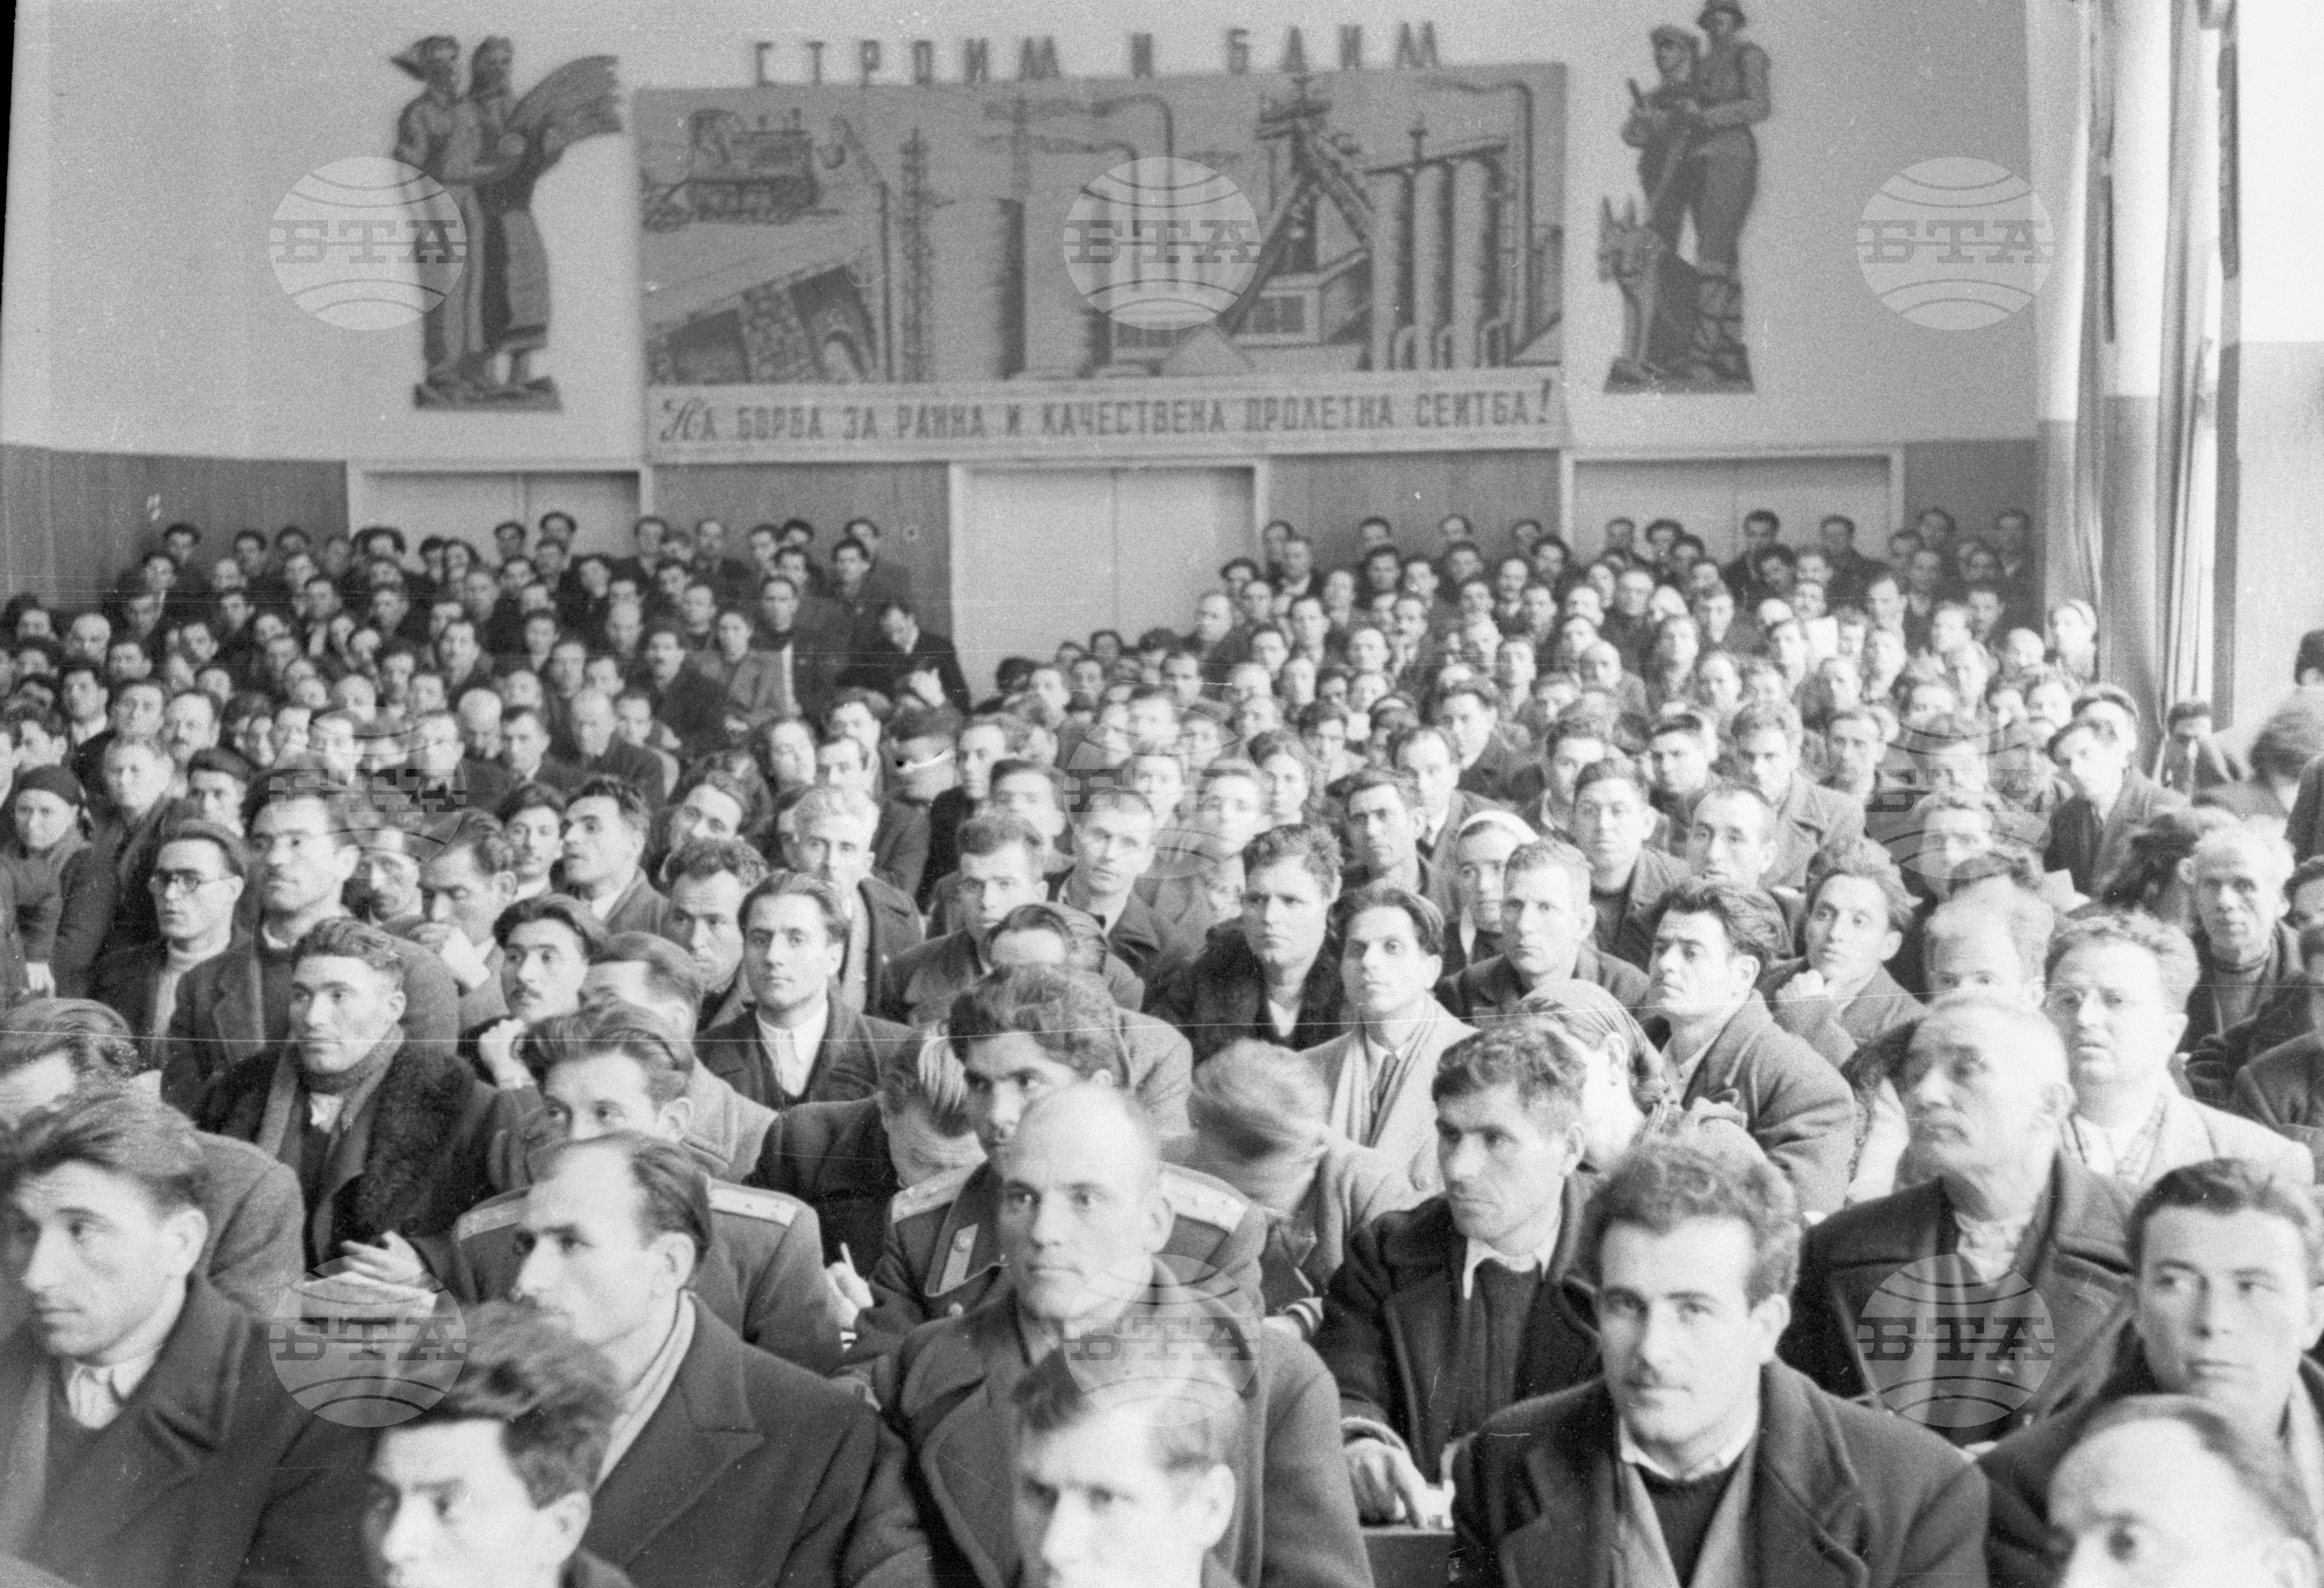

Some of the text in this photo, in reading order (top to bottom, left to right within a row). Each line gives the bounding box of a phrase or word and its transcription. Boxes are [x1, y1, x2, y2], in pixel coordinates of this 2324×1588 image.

[736, 405, 823, 441] БОРБА
[842, 405, 878, 440] ЗА
[1006, 404, 1022, 437] И
[1043, 398, 1226, 437] КАЧЕСТВЕНА
[1244, 393, 1393, 433] ПРОЛЕТНА
[1414, 378, 1553, 429] СЕИТБА!
